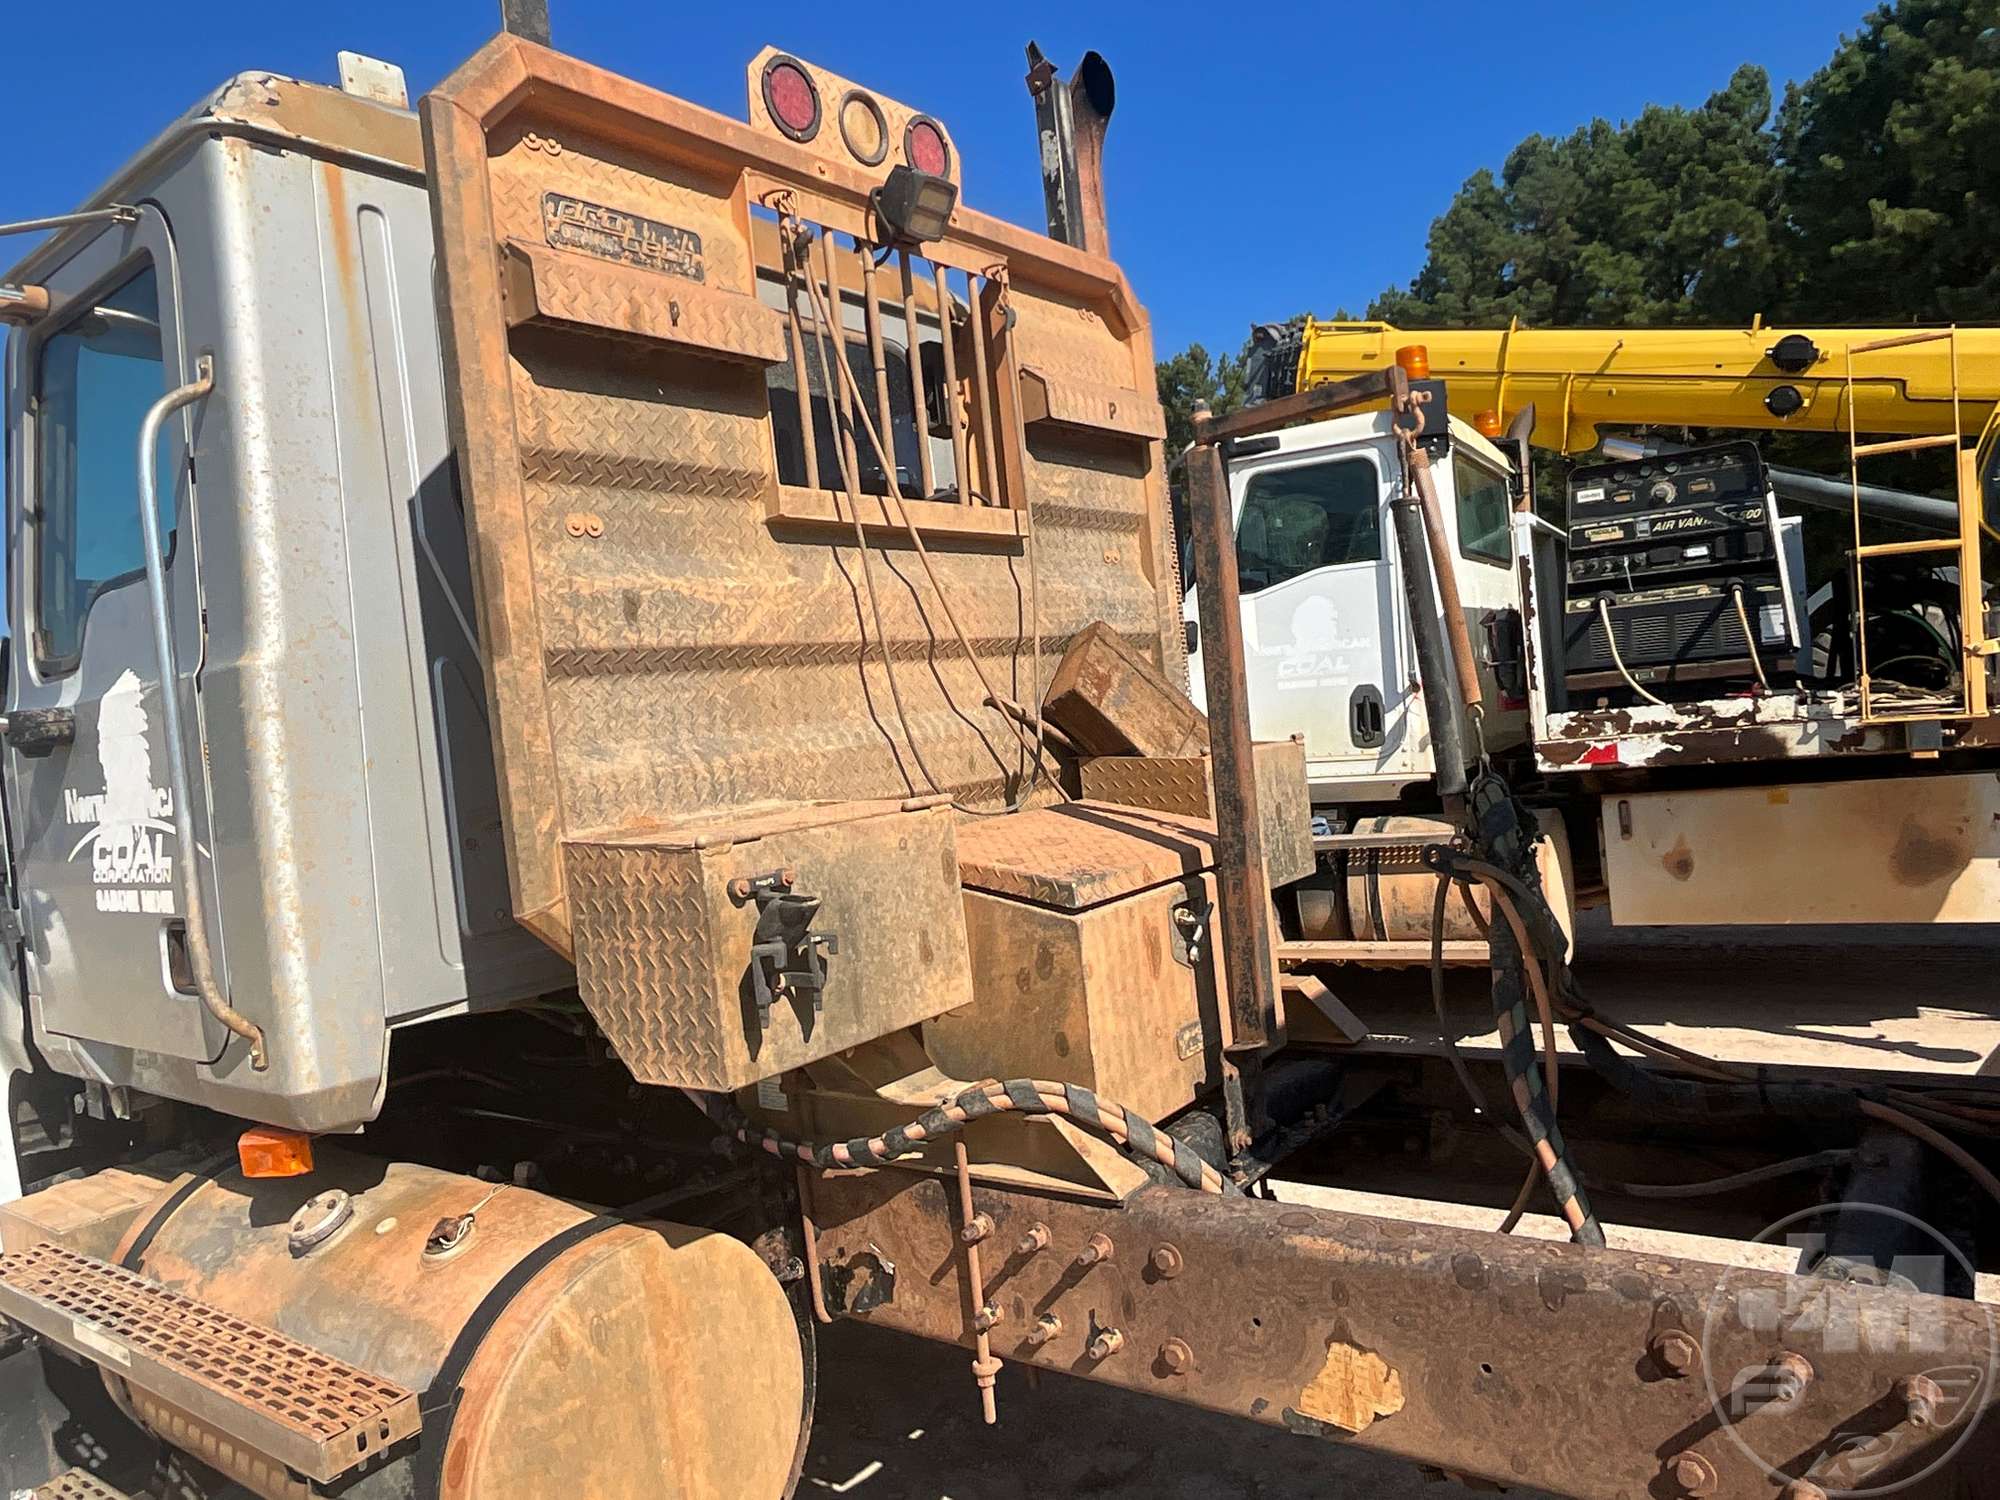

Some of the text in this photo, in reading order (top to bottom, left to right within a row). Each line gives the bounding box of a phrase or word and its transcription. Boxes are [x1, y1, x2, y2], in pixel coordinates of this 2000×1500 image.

[1652, 519, 1674, 532] AIR
[93, 834, 172, 870] COAL
[93, 868, 172, 884] CORPORATION
